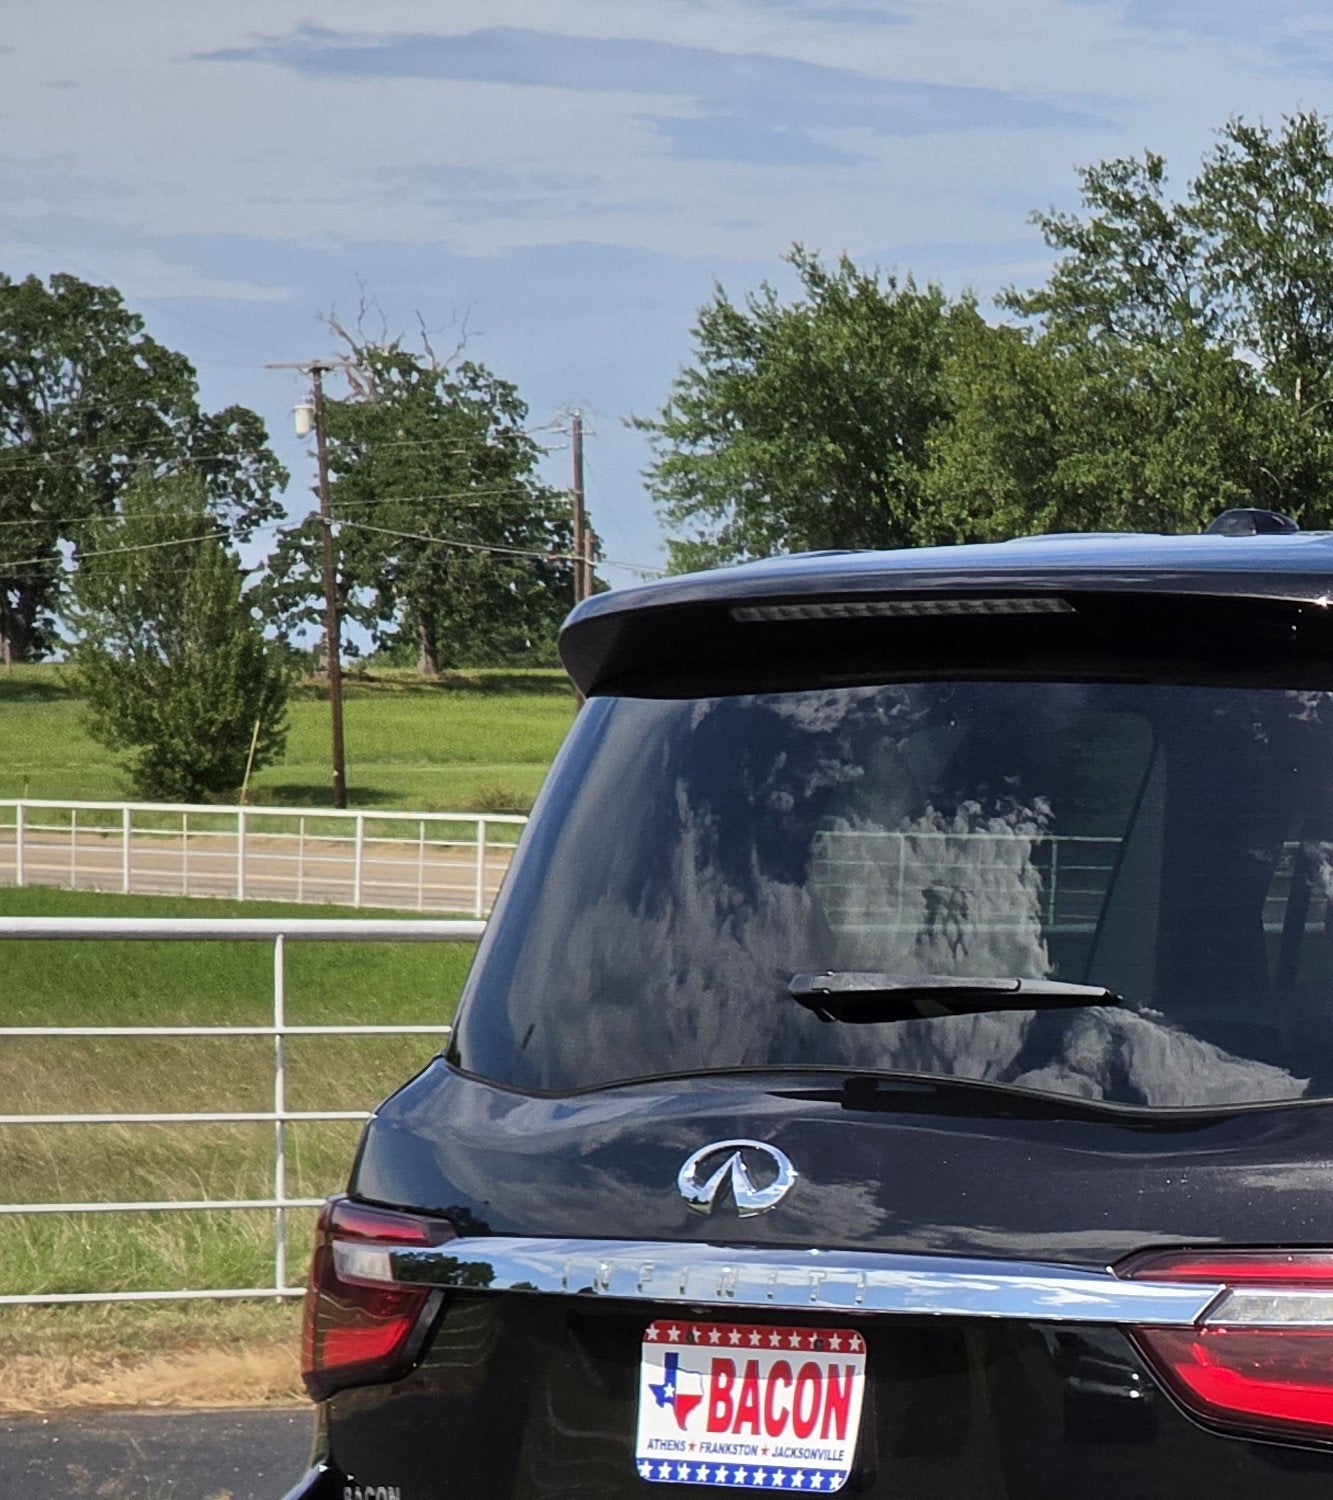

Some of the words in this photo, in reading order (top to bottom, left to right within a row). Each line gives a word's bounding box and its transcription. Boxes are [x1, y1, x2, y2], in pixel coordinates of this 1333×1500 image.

[706, 1357, 856, 1441] BACON
[647, 1438, 686, 1452] ATHENS
[699, 1442, 759, 1457] FRANKSTON
[772, 1446, 845, 1462] JACKSONVILLE
